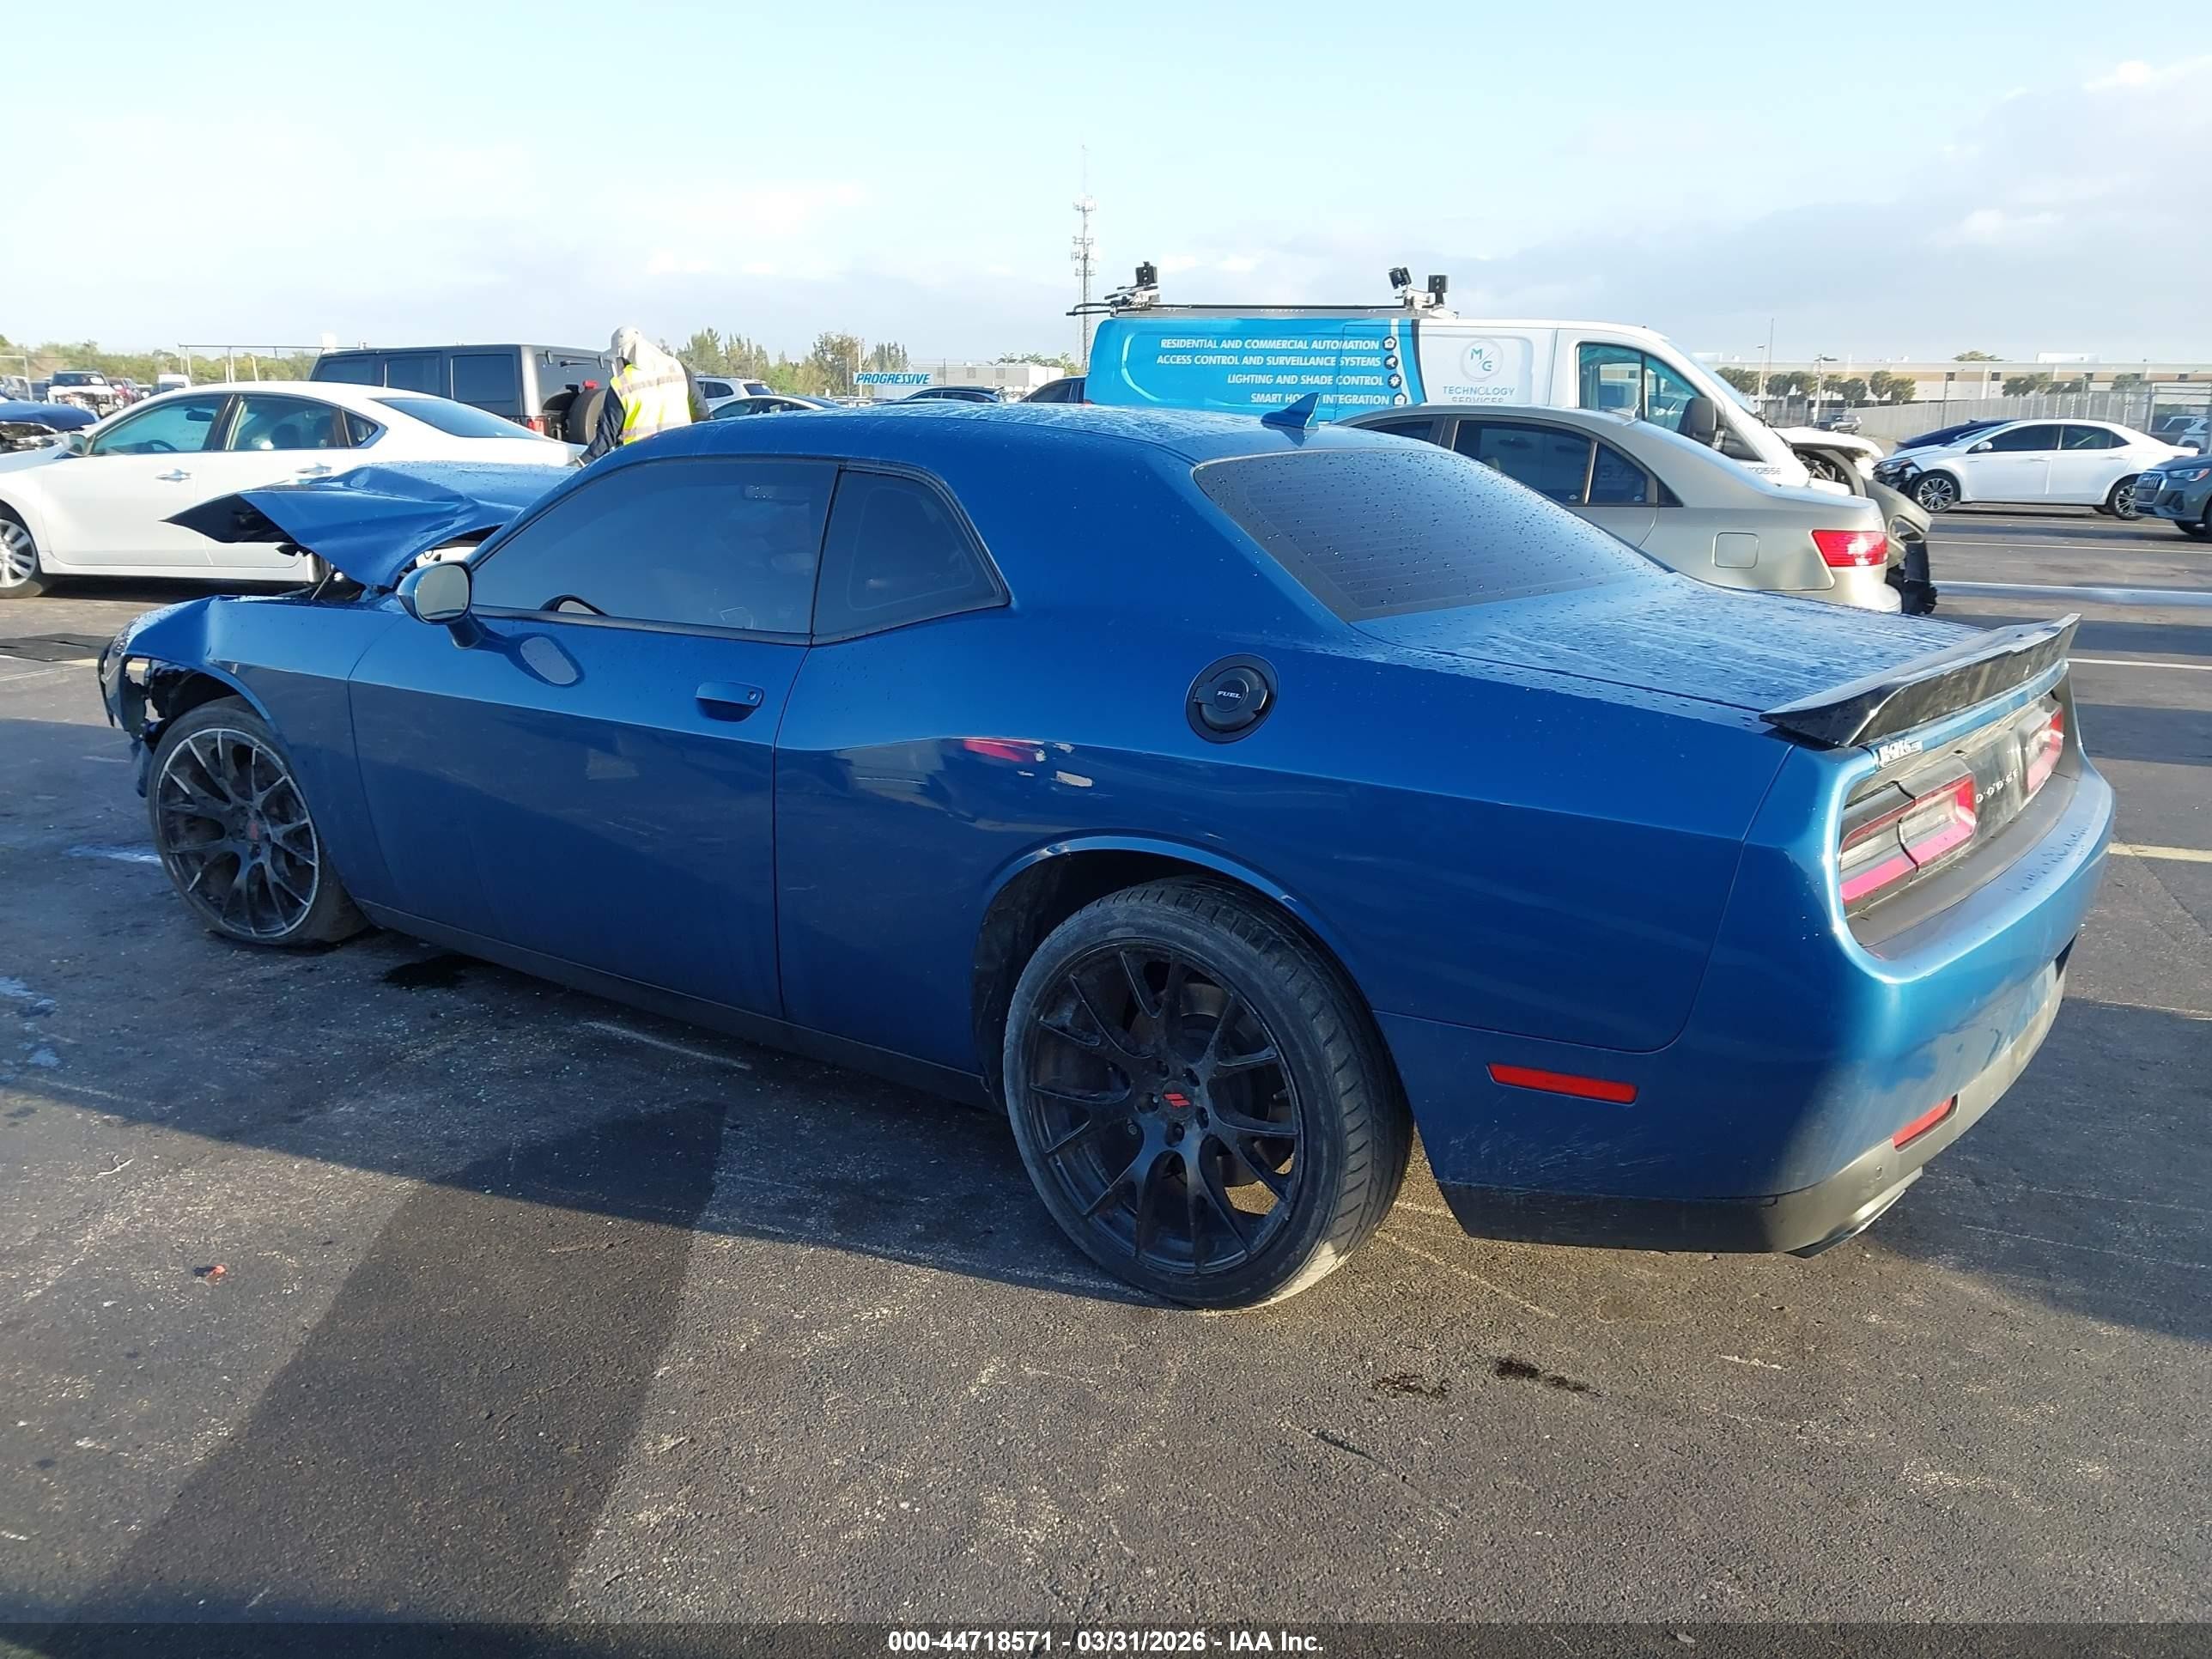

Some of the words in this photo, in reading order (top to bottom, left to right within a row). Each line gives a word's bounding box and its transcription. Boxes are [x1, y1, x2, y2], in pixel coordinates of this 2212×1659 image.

[1160, 338, 1218, 349] RESIDENTIAL
[1220, 339, 1243, 349] AND
[1244, 339, 1309, 349] COMMERCIAL
[1310, 339, 1379, 350] AUTOMATION
[1156, 354, 1192, 364] ACCESS
[1194, 355, 1239, 365] CONTROL
[1242, 356, 1264, 365] AND
[1266, 356, 1336, 366] SURVEILLANCE
[1340, 356, 1382, 367] SYSTEMS
[855, 373, 931, 385] PROGRESSIVE
[1227, 374, 1273, 385] LIGHTING
[1275, 374, 1298, 385] AND
[1300, 374, 1334, 386] SHADE
[1336, 375, 1384, 386] CONTROL
[1443, 386, 1515, 396] TECHNOLOGY
[1250, 392, 1283, 404] SMART
[1322, 394, 1389, 405] INTEGRATION
[1217, 690, 1242, 699] FUEL
